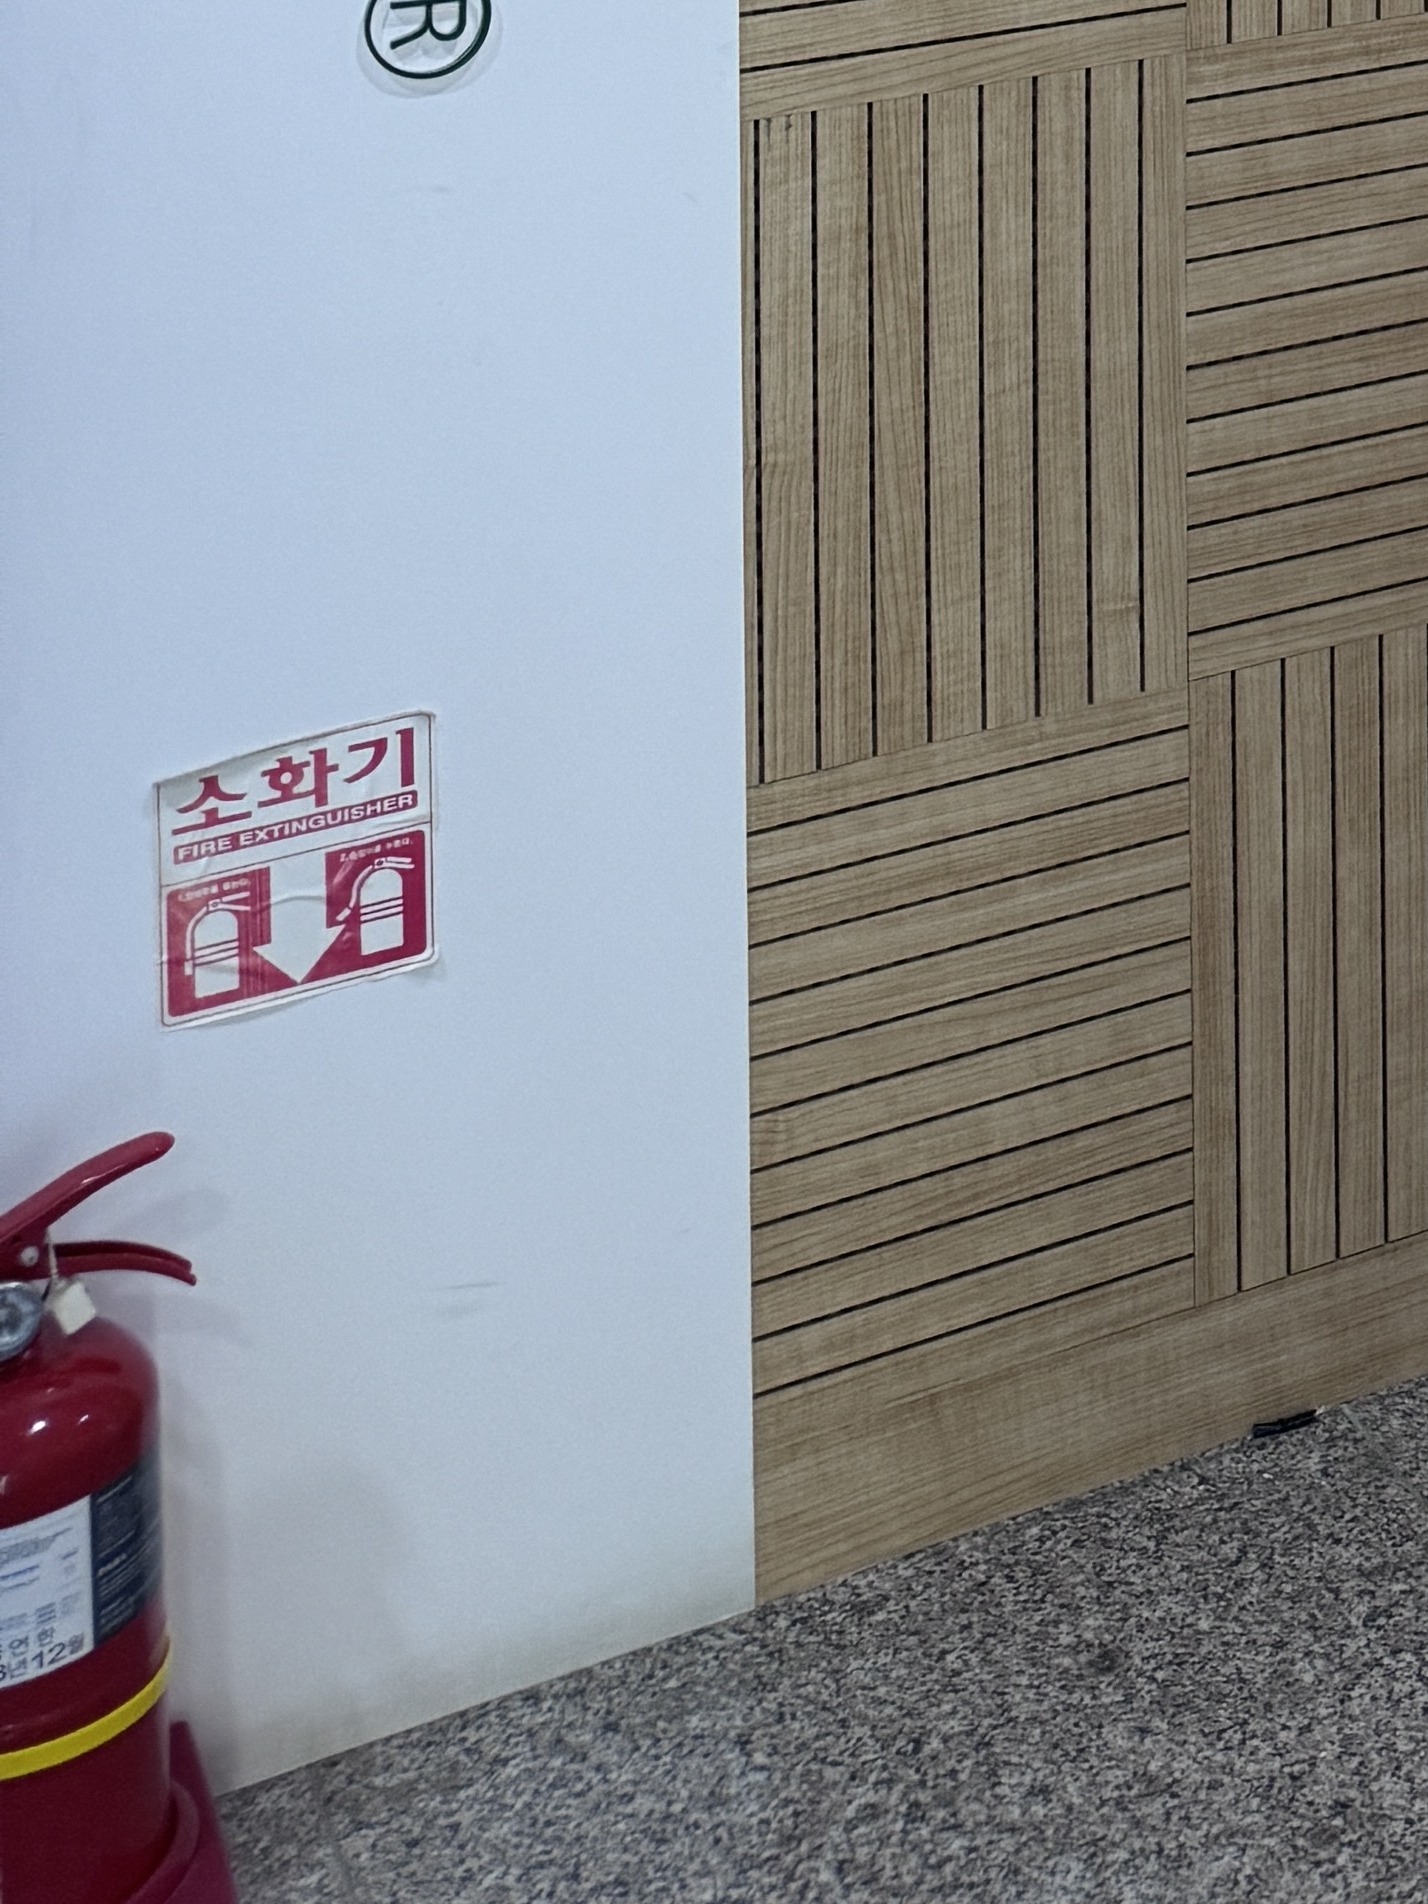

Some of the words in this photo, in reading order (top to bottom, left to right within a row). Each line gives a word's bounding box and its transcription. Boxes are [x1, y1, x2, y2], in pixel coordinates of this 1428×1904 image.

[171, 727, 415, 836] 소화기
[177, 836, 232, 861] FIRE
[240, 794, 414, 849] EXTINGUISHER
